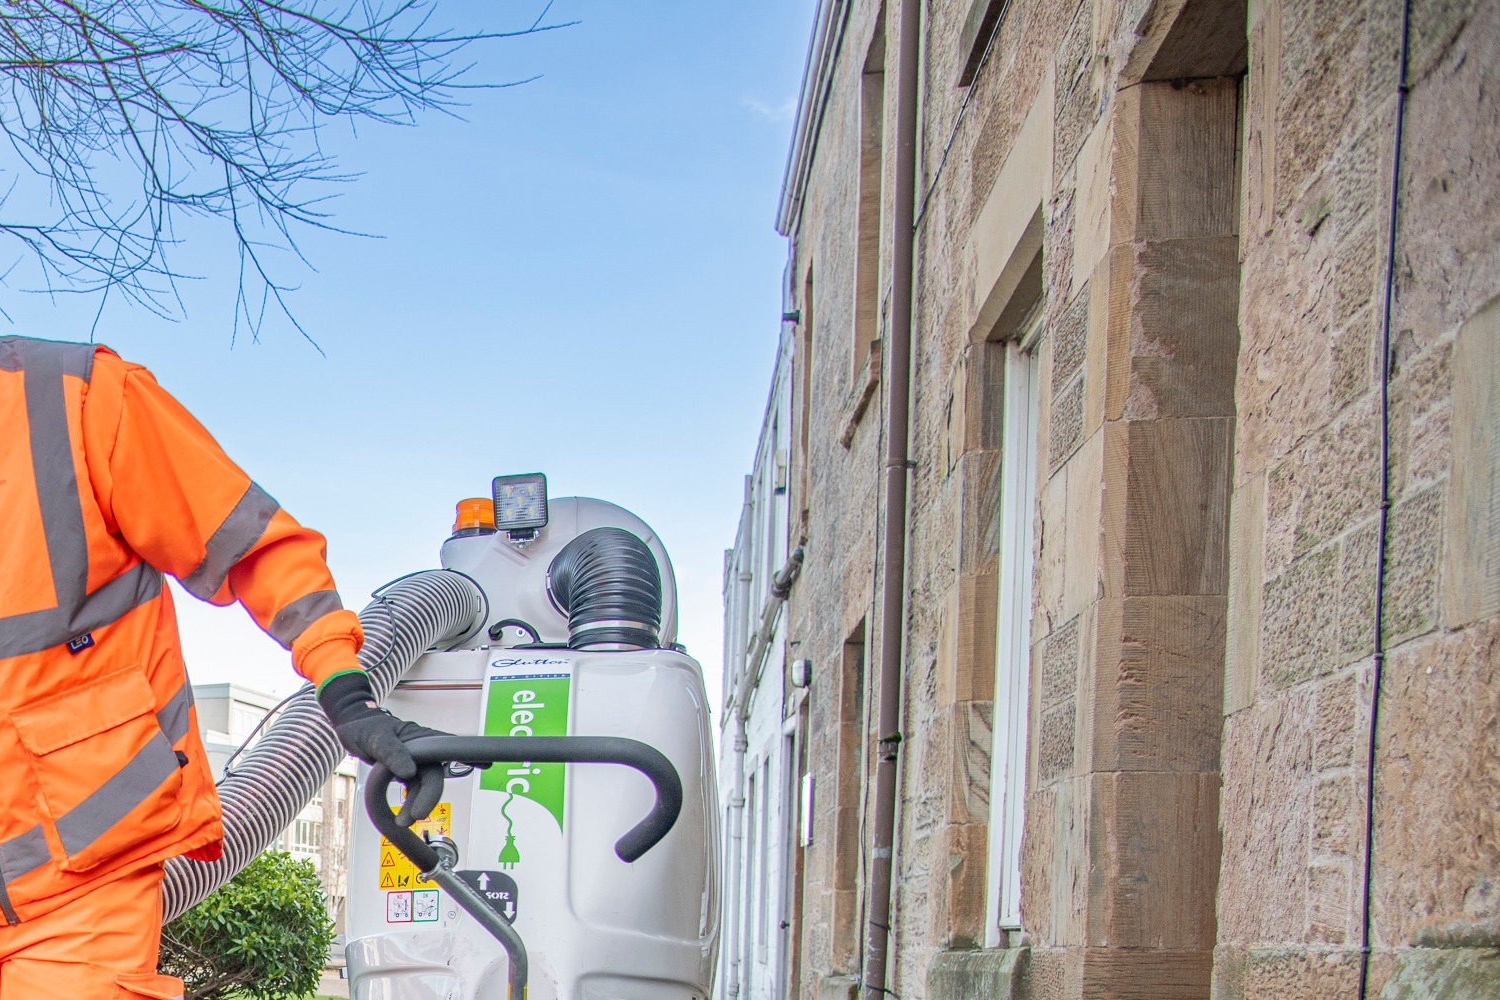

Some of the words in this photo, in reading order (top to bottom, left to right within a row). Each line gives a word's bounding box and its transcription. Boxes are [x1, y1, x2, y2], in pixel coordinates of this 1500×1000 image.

[70, 635, 89, 650] LEO
[491, 658, 570, 668] Glutton
[505, 689, 545, 794] elecic
